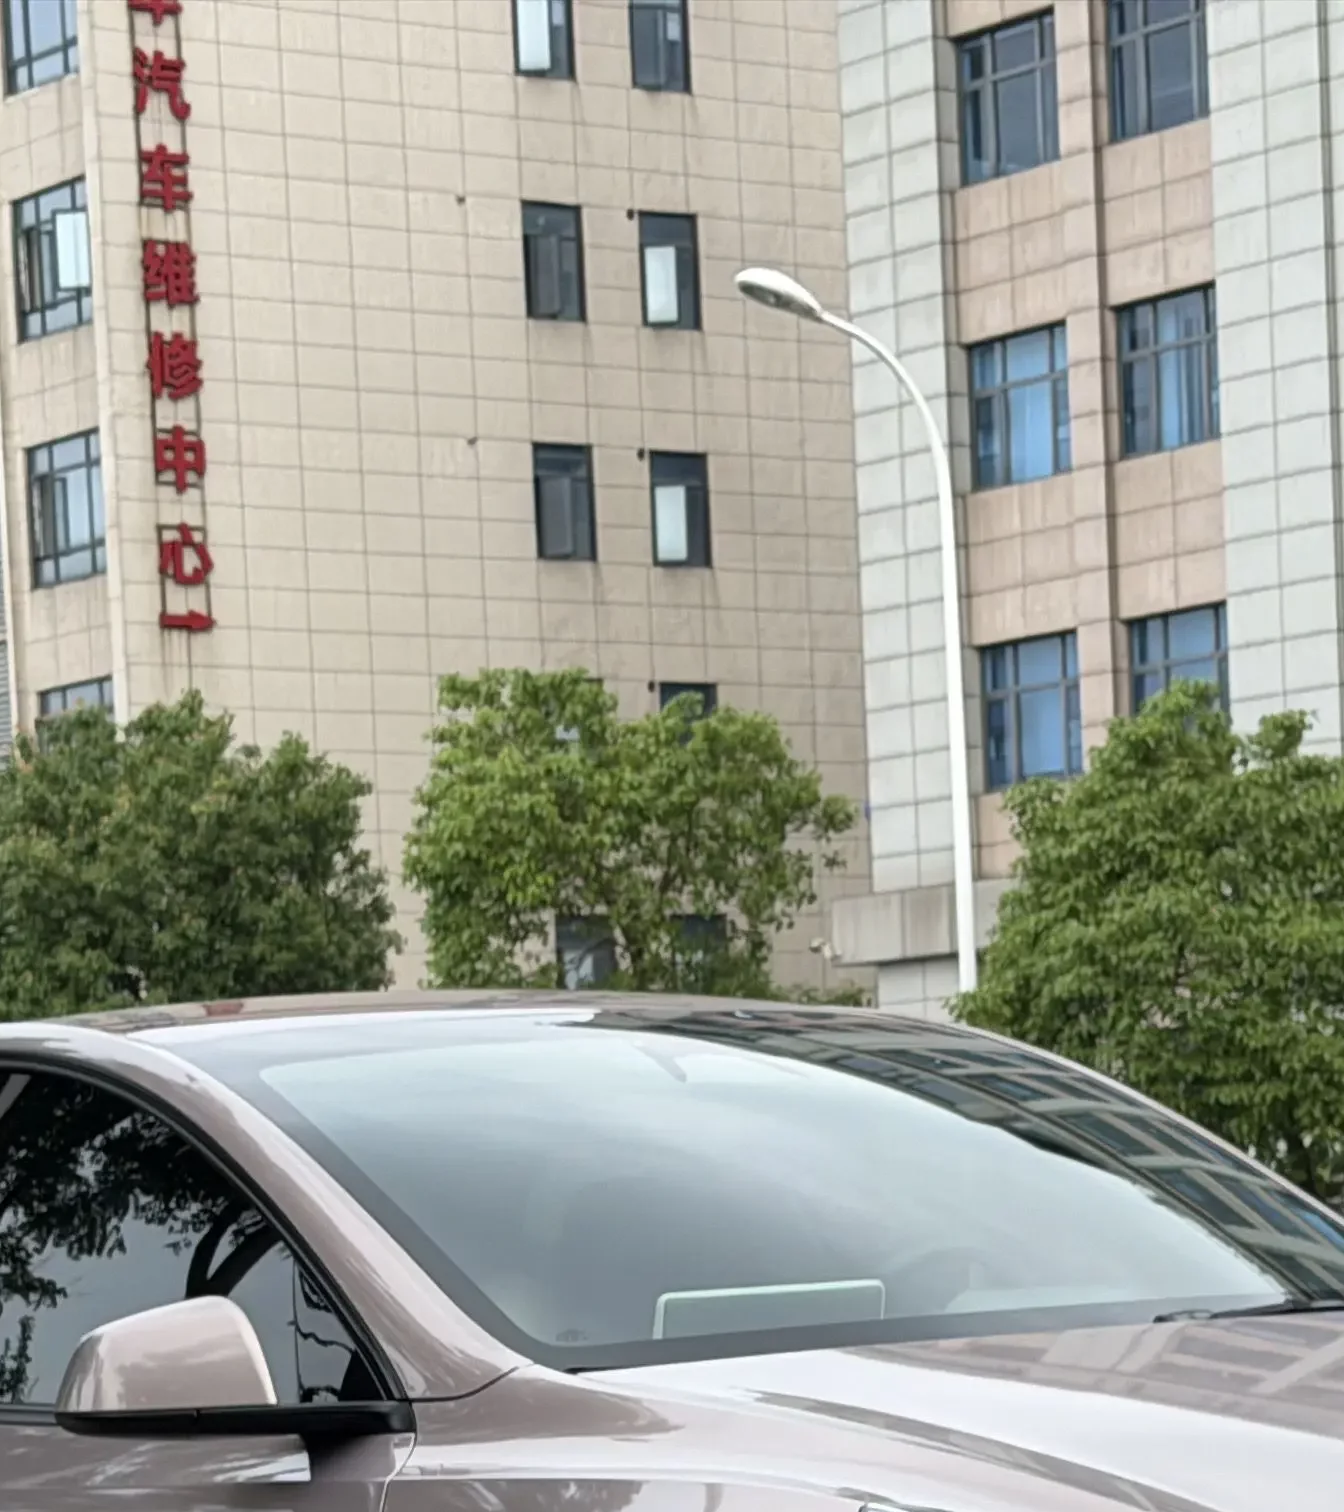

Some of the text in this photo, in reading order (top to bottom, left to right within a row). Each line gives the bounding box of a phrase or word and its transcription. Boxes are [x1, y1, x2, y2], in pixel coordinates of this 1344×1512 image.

[128, 0, 214, 587] 汽车维修中心
